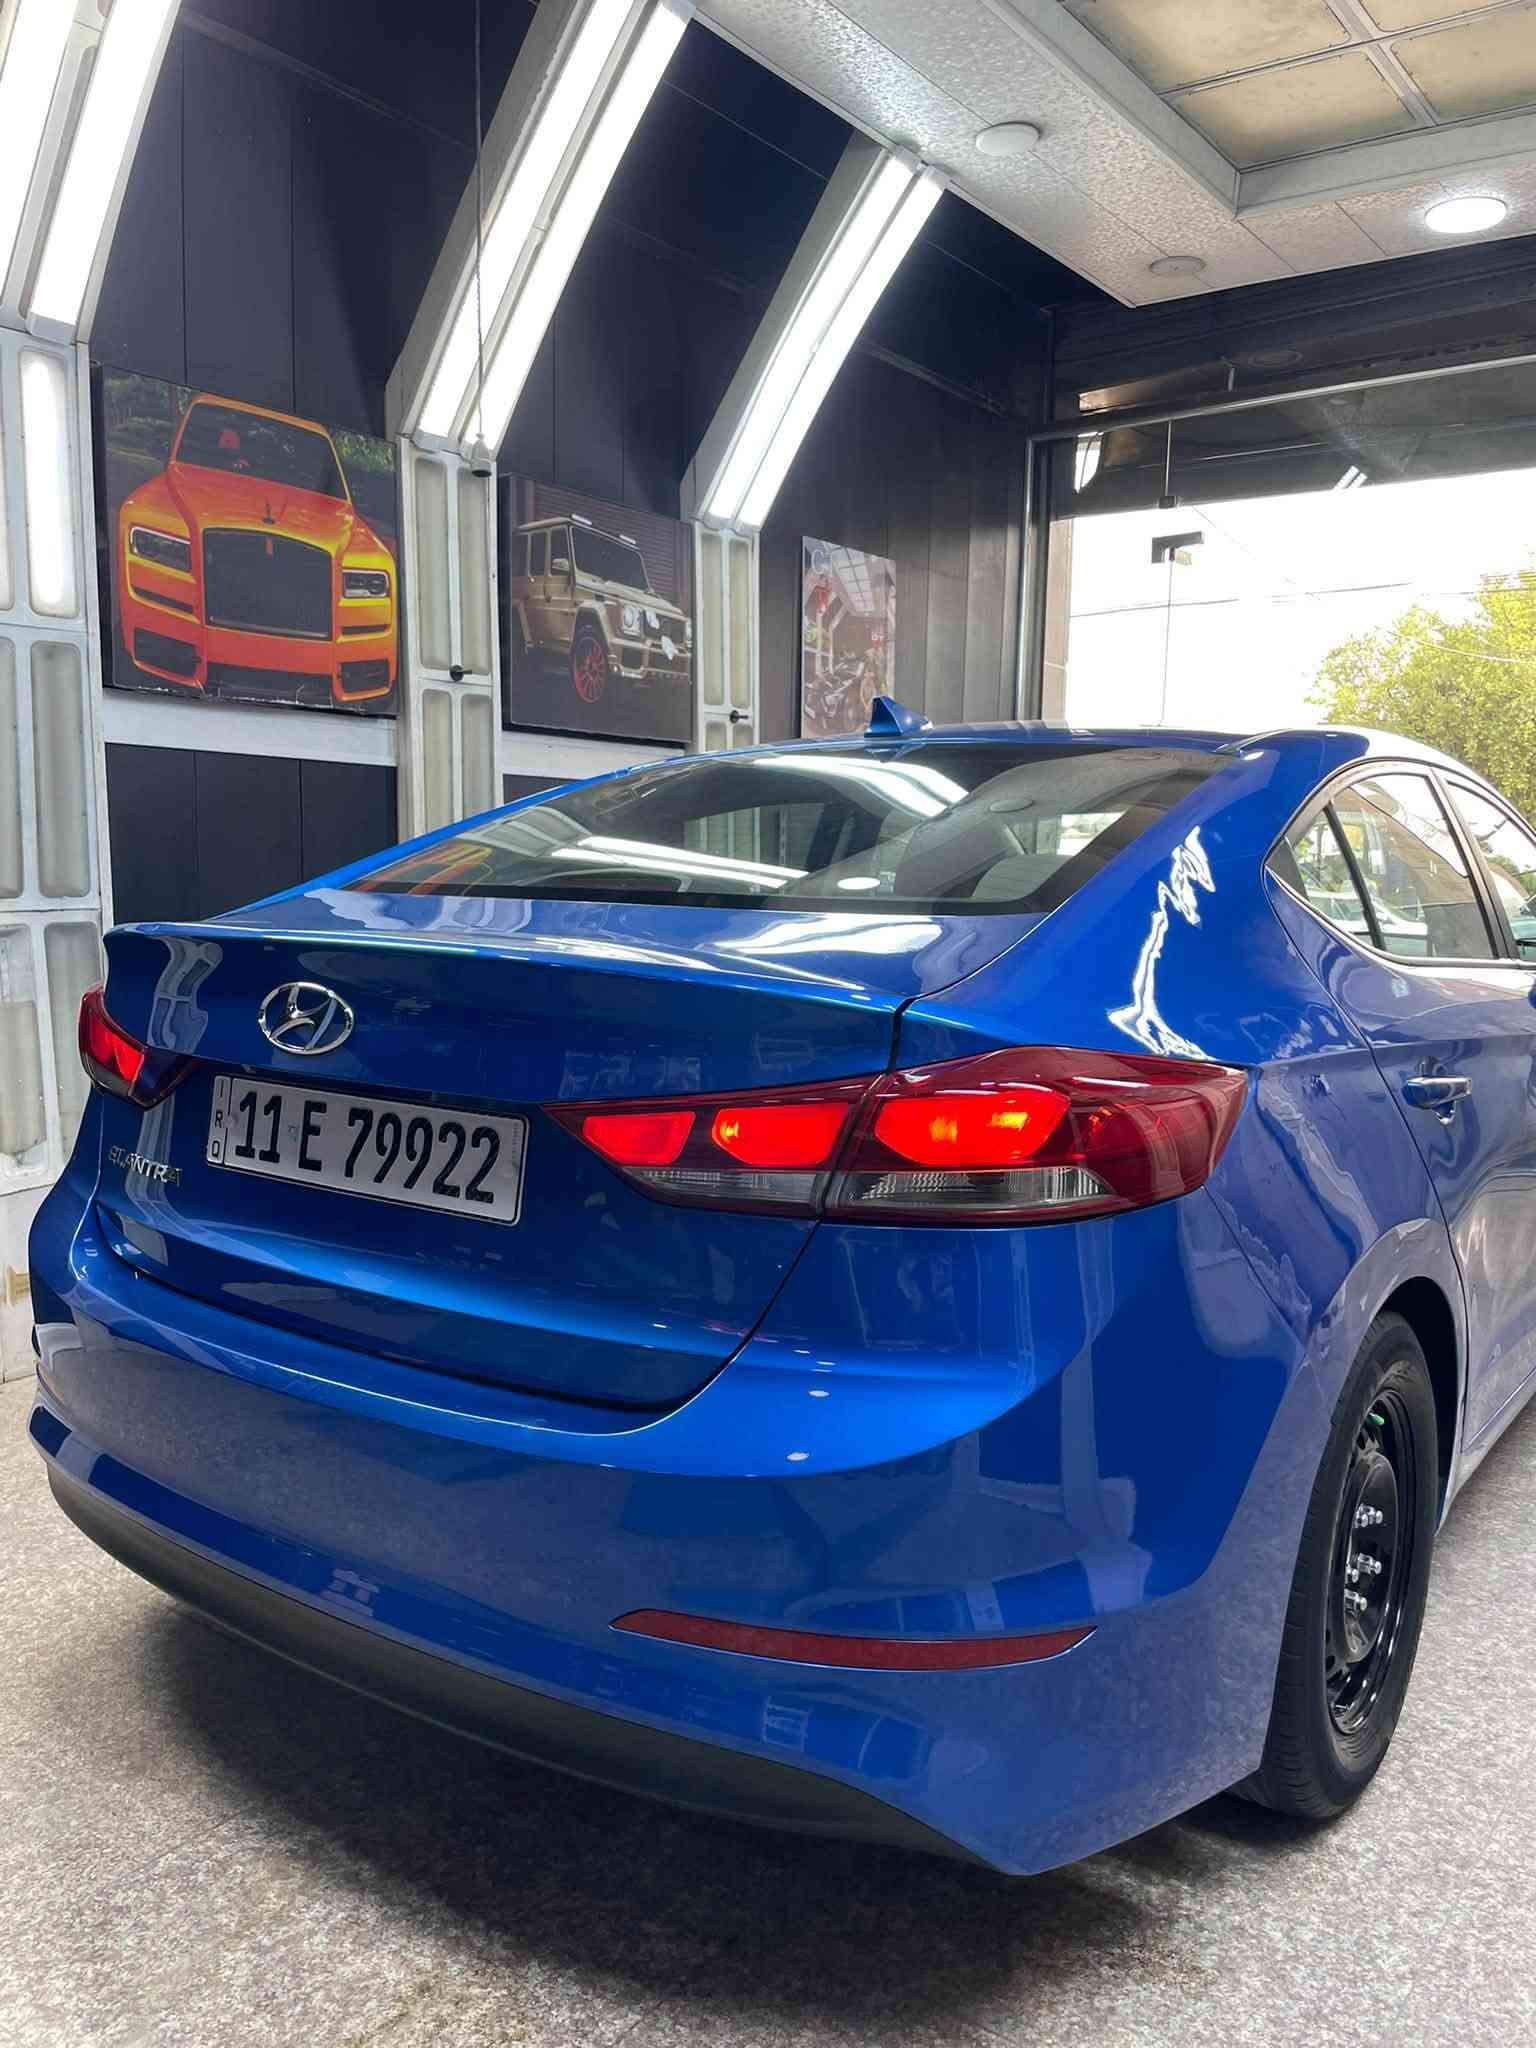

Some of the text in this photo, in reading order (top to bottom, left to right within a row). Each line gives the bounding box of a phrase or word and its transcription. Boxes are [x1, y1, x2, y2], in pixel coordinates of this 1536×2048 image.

[235, 1091, 282, 1163] 11
[298, 1100, 327, 1171] E
[344, 1107, 500, 1204] 79922
